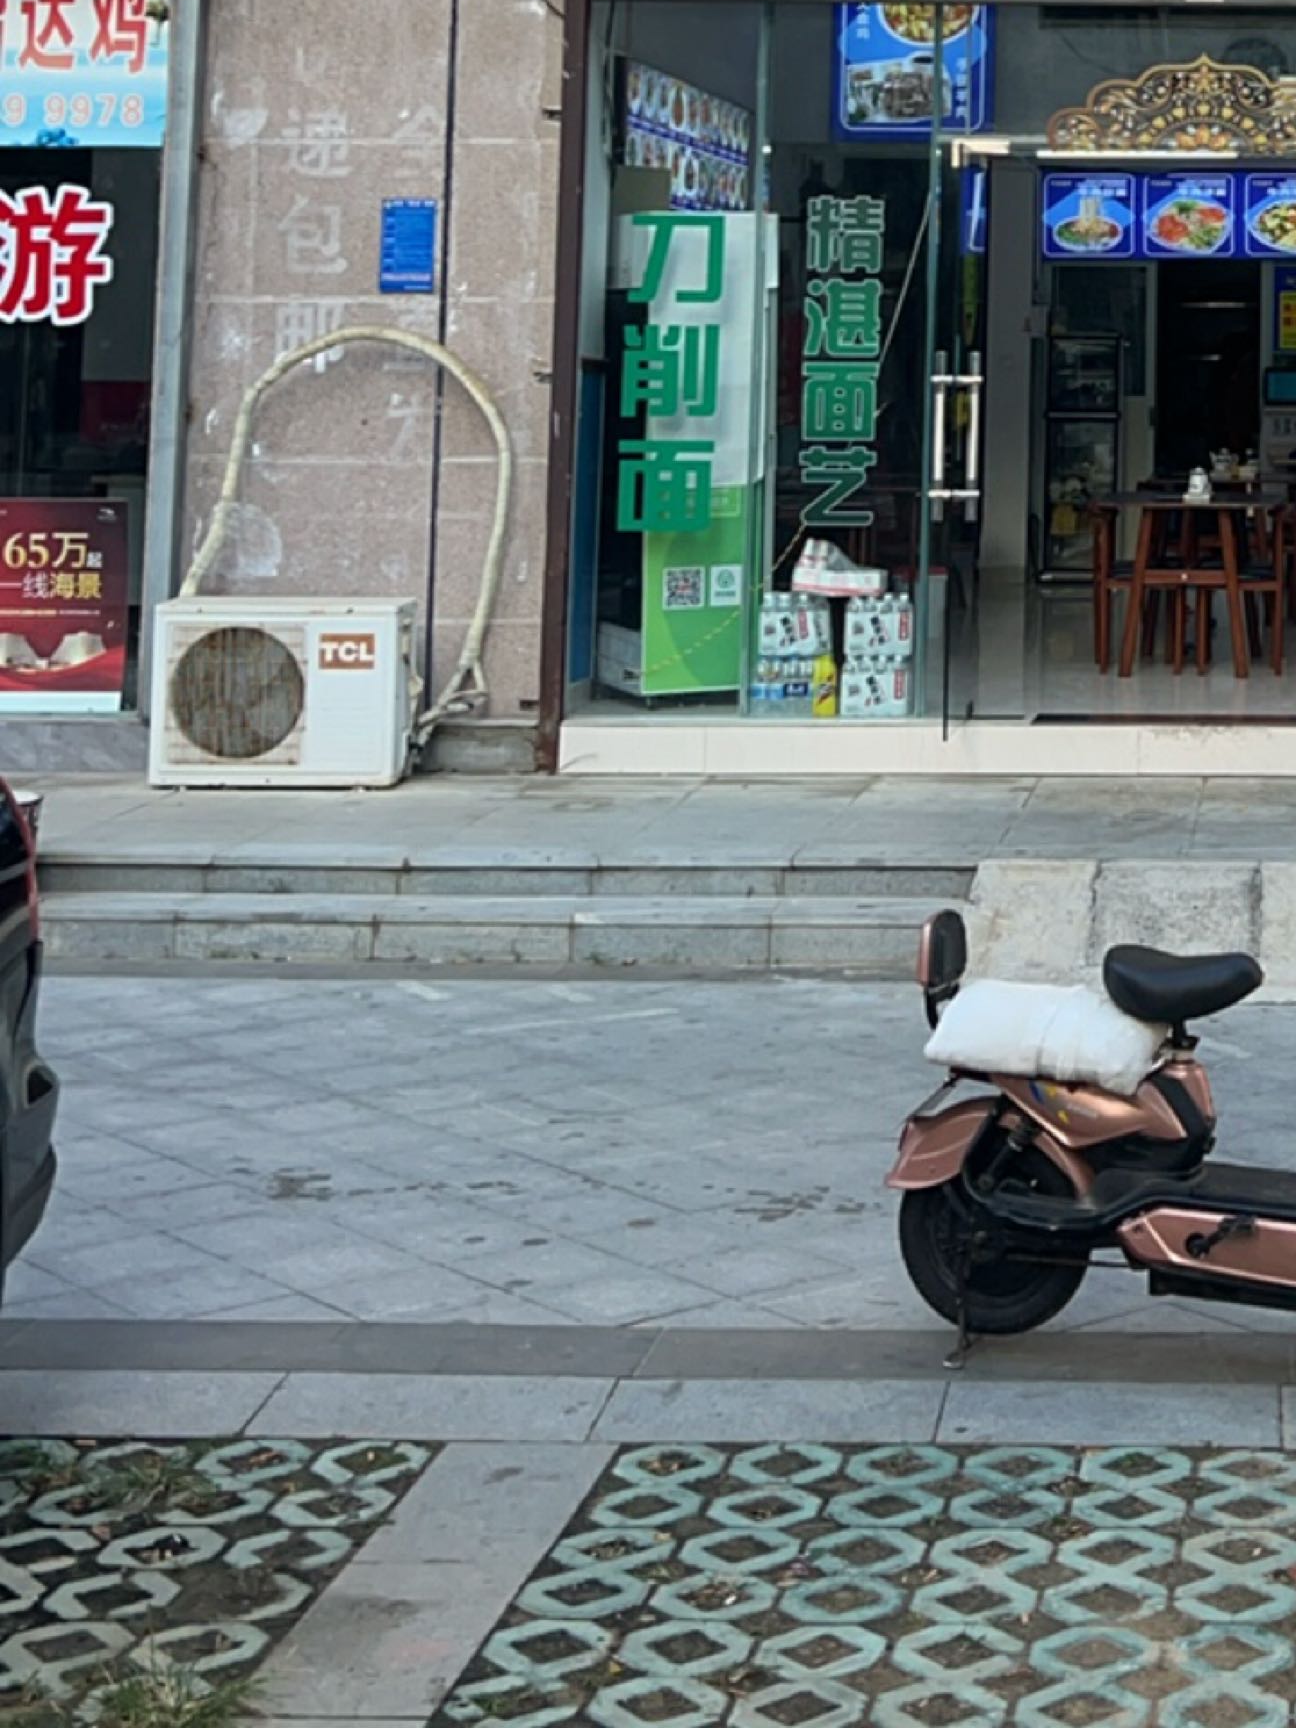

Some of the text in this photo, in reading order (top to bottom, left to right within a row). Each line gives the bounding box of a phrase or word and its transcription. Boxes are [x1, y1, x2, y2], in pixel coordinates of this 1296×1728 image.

[43, 93, 145, 127] 9978
[617, 216, 725, 532] 刀削面
[799, 194, 885, 526] 精湛面艺
[319, 639, 375, 664] TCL
